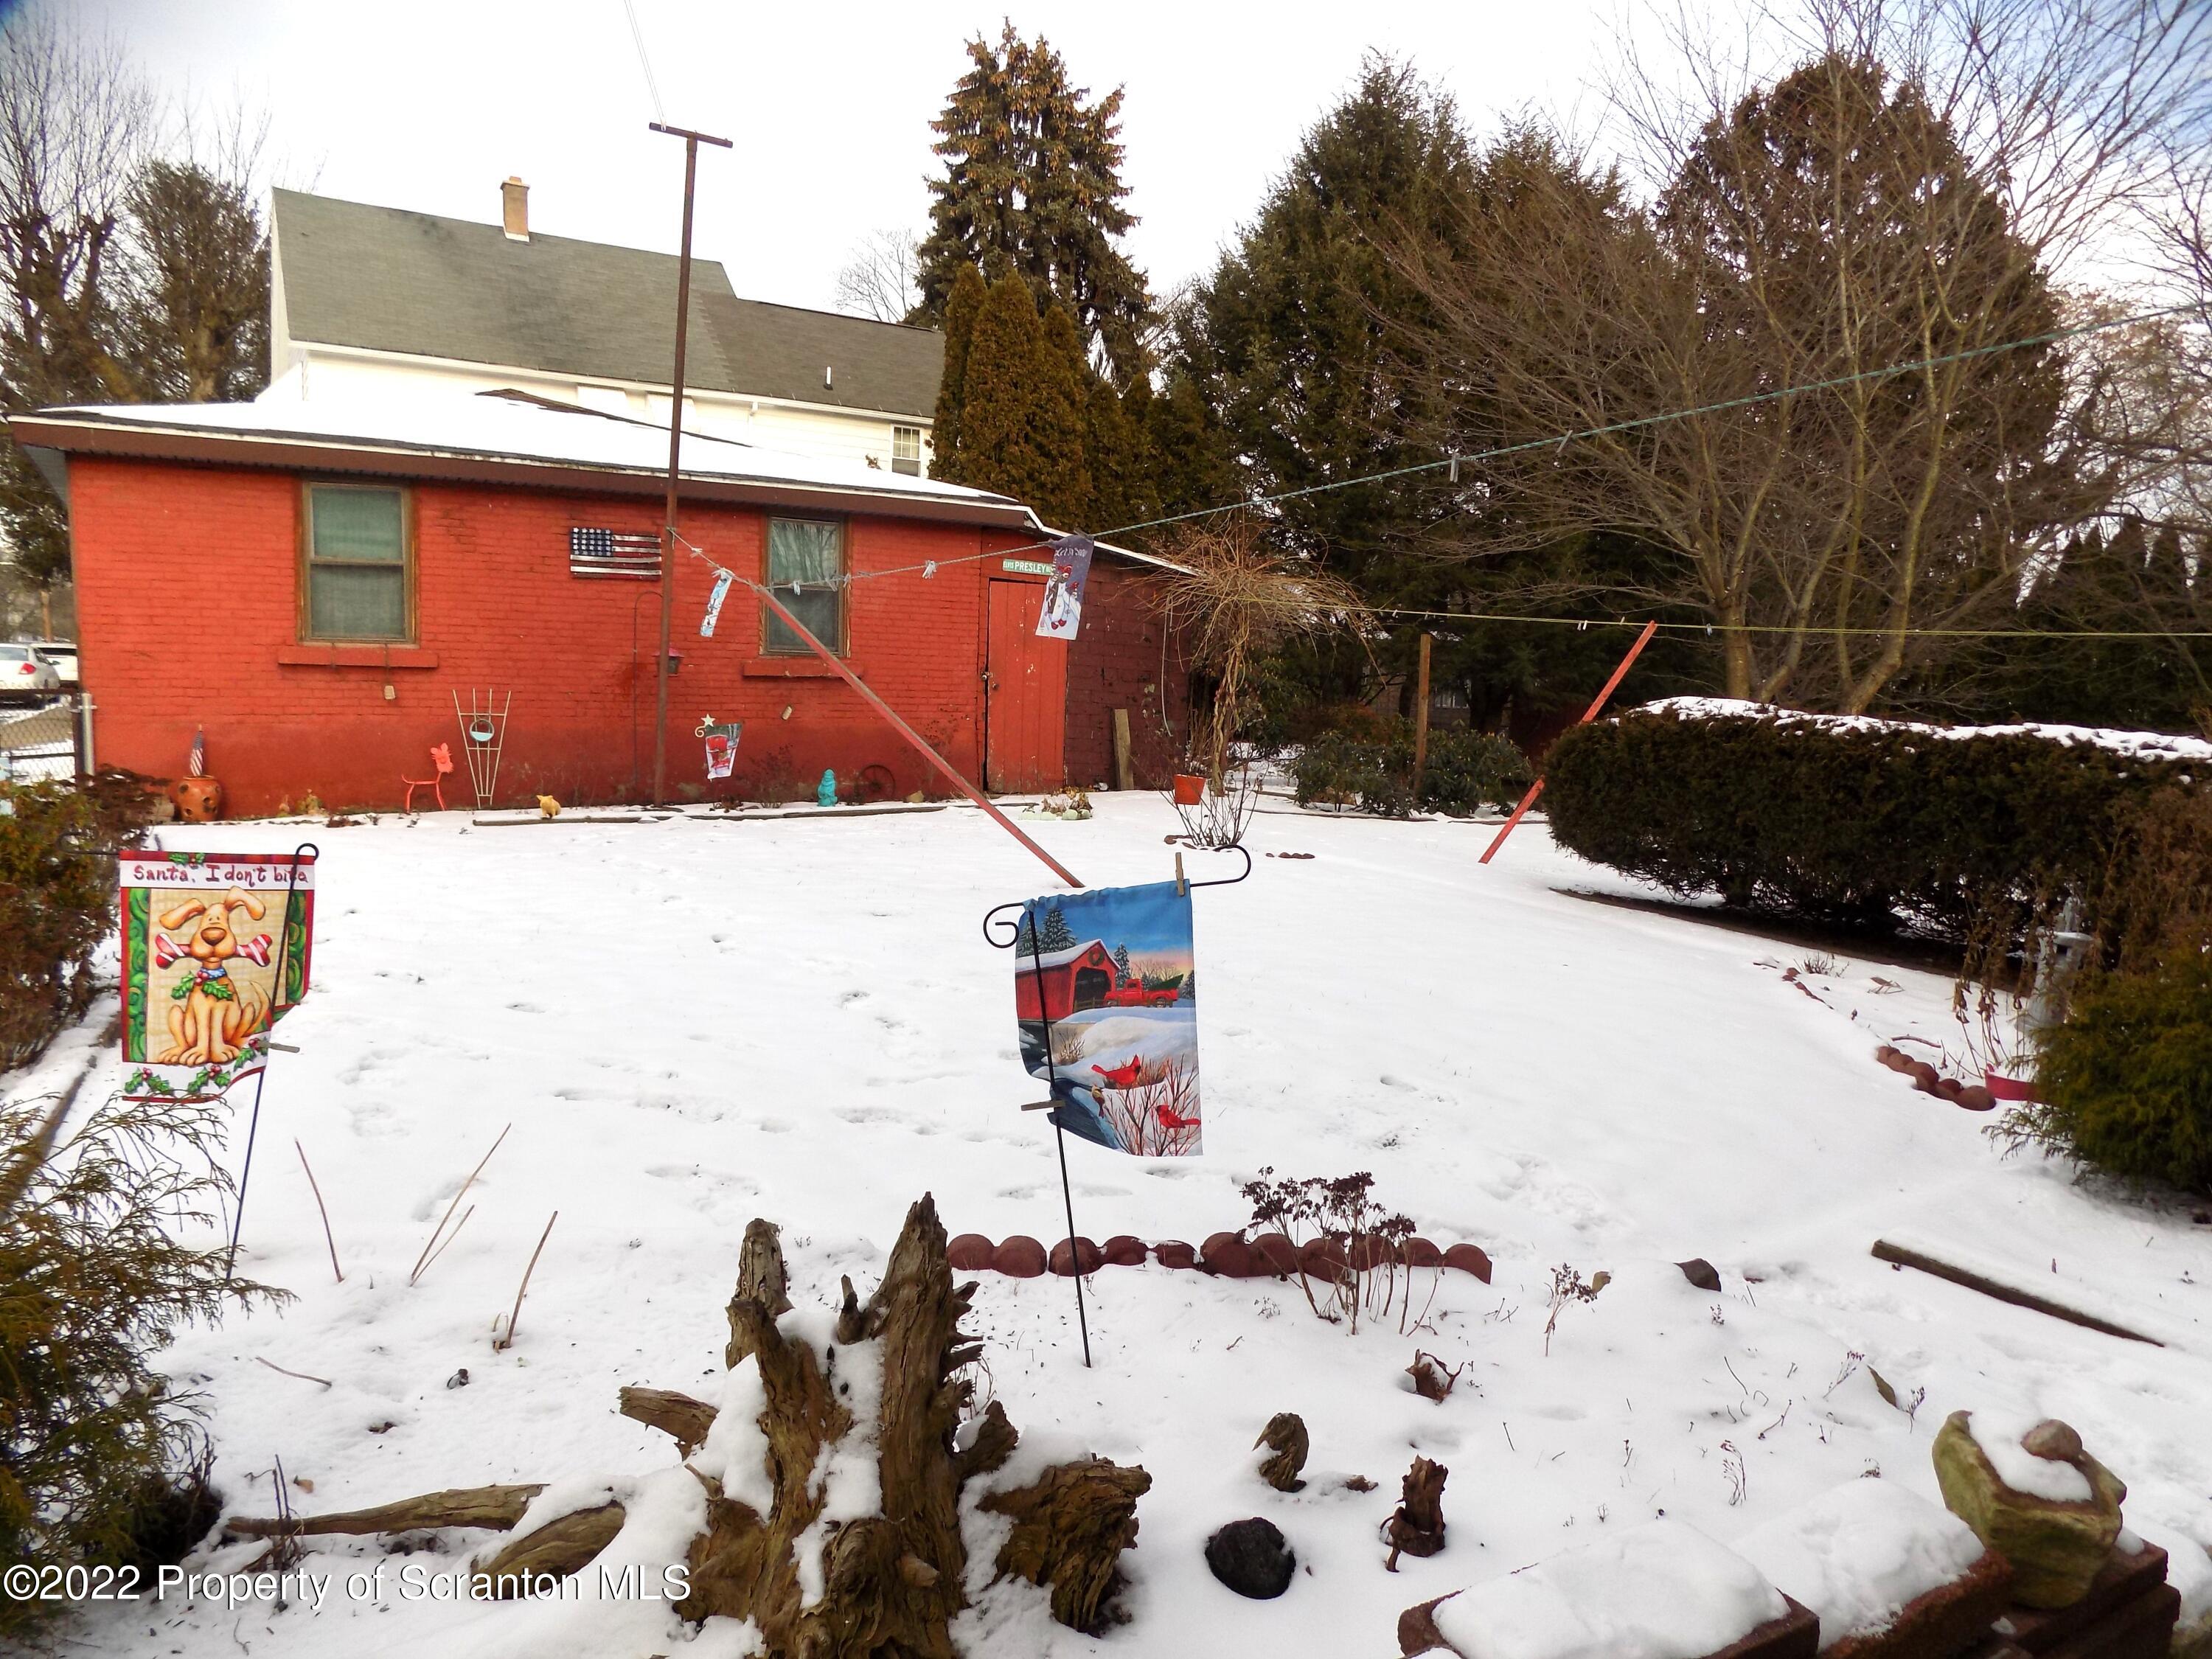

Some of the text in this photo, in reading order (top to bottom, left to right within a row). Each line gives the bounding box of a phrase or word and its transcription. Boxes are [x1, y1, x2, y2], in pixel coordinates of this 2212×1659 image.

[1003, 560, 1015, 568] ELVIS
[1015, 561, 1046, 573] PRESLEY
[206, 864, 220, 882] I
[225, 865, 266, 887] don't
